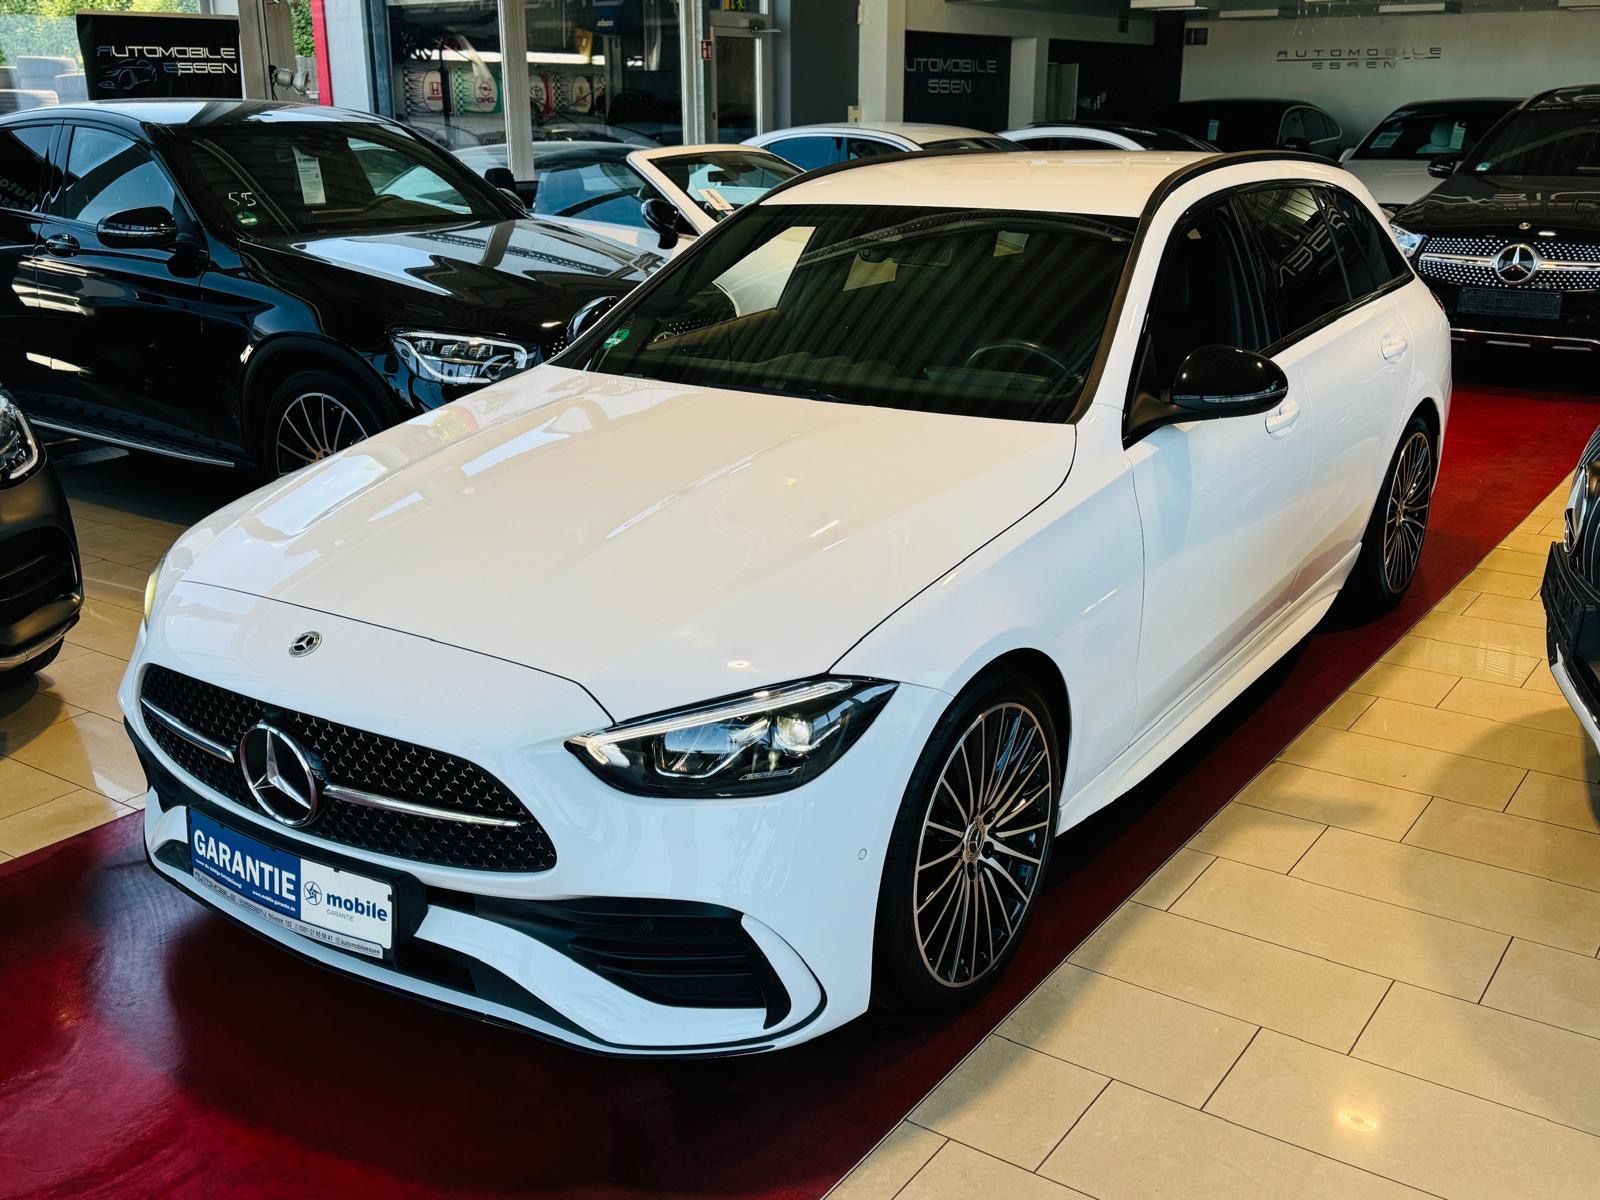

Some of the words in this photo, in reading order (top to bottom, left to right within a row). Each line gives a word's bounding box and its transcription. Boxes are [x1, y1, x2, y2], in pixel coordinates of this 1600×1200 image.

[97, 45, 236, 58] AUTOMOBILE
[1276, 47, 1442, 58] AUTOMOBILE
[163, 61, 238, 76] ESSEN
[905, 57, 998, 73] UTOMOBILE
[927, 79, 972, 94] SSEN
[193, 829, 297, 902] GARANTIE
[326, 892, 388, 922] mobile
[326, 908, 354, 922] GARANTIE
